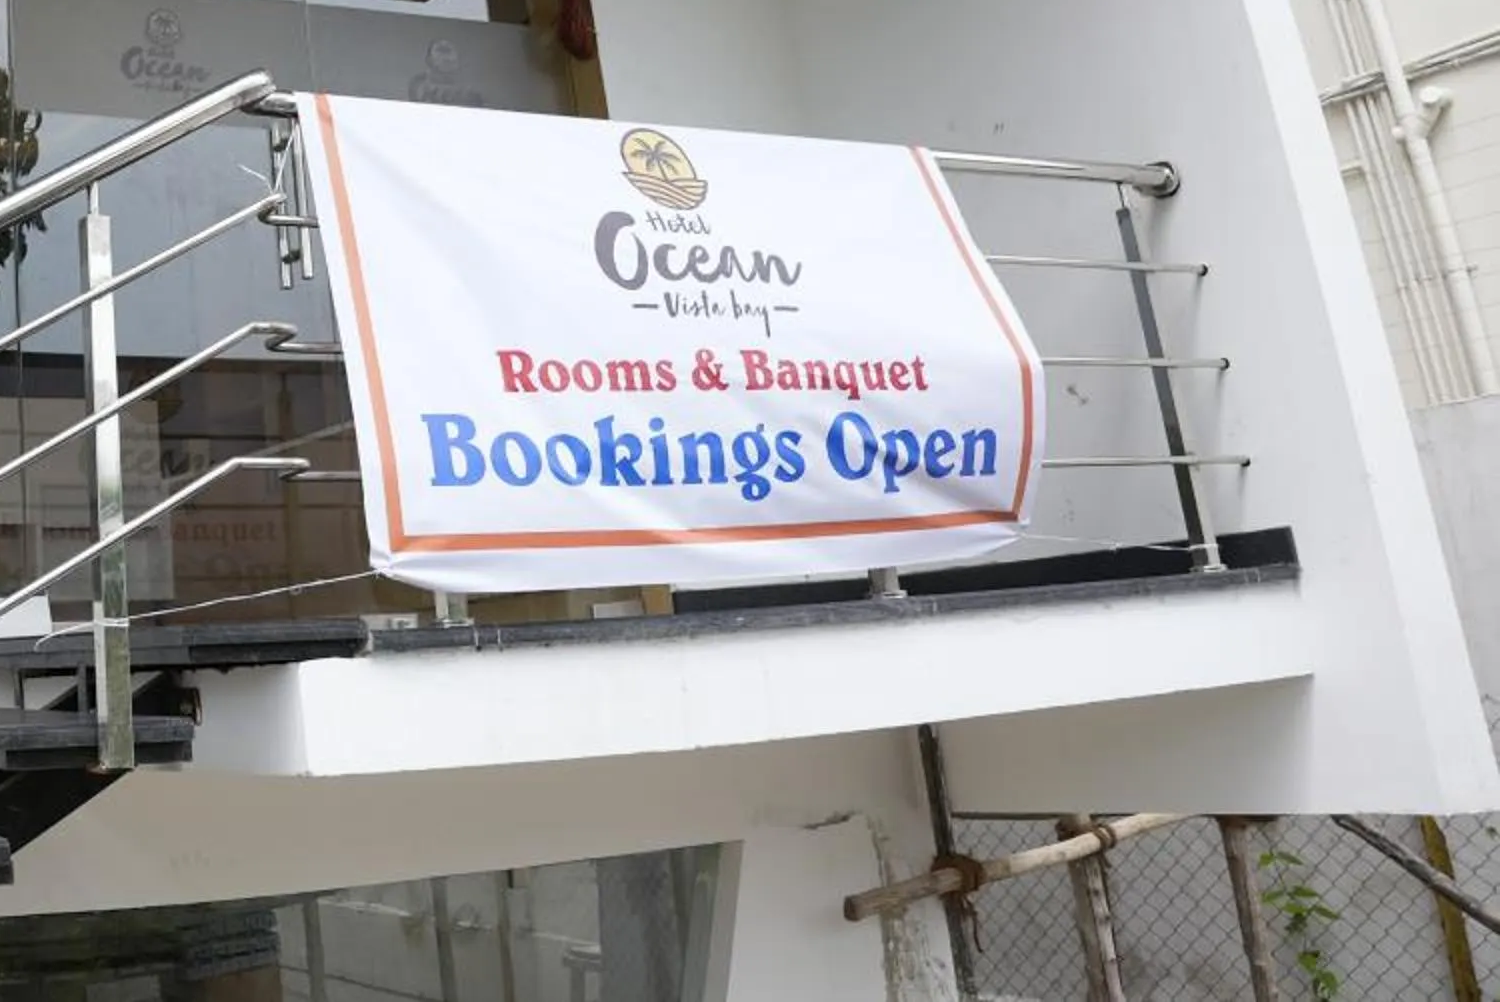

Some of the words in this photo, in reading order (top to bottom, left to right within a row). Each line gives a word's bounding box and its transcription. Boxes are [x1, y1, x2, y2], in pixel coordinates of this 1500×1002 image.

[646, 210, 711, 235] Hotel
[594, 211, 802, 291] Ocean
[663, 289, 726, 319] Vista
[729, 288, 772, 338] bay
[496, 348, 678, 394] Rooms
[691, 347, 730, 392] &
[739, 348, 929, 401] Banquet
[420, 412, 807, 502] Bookings
[825, 410, 997, 494] Open
